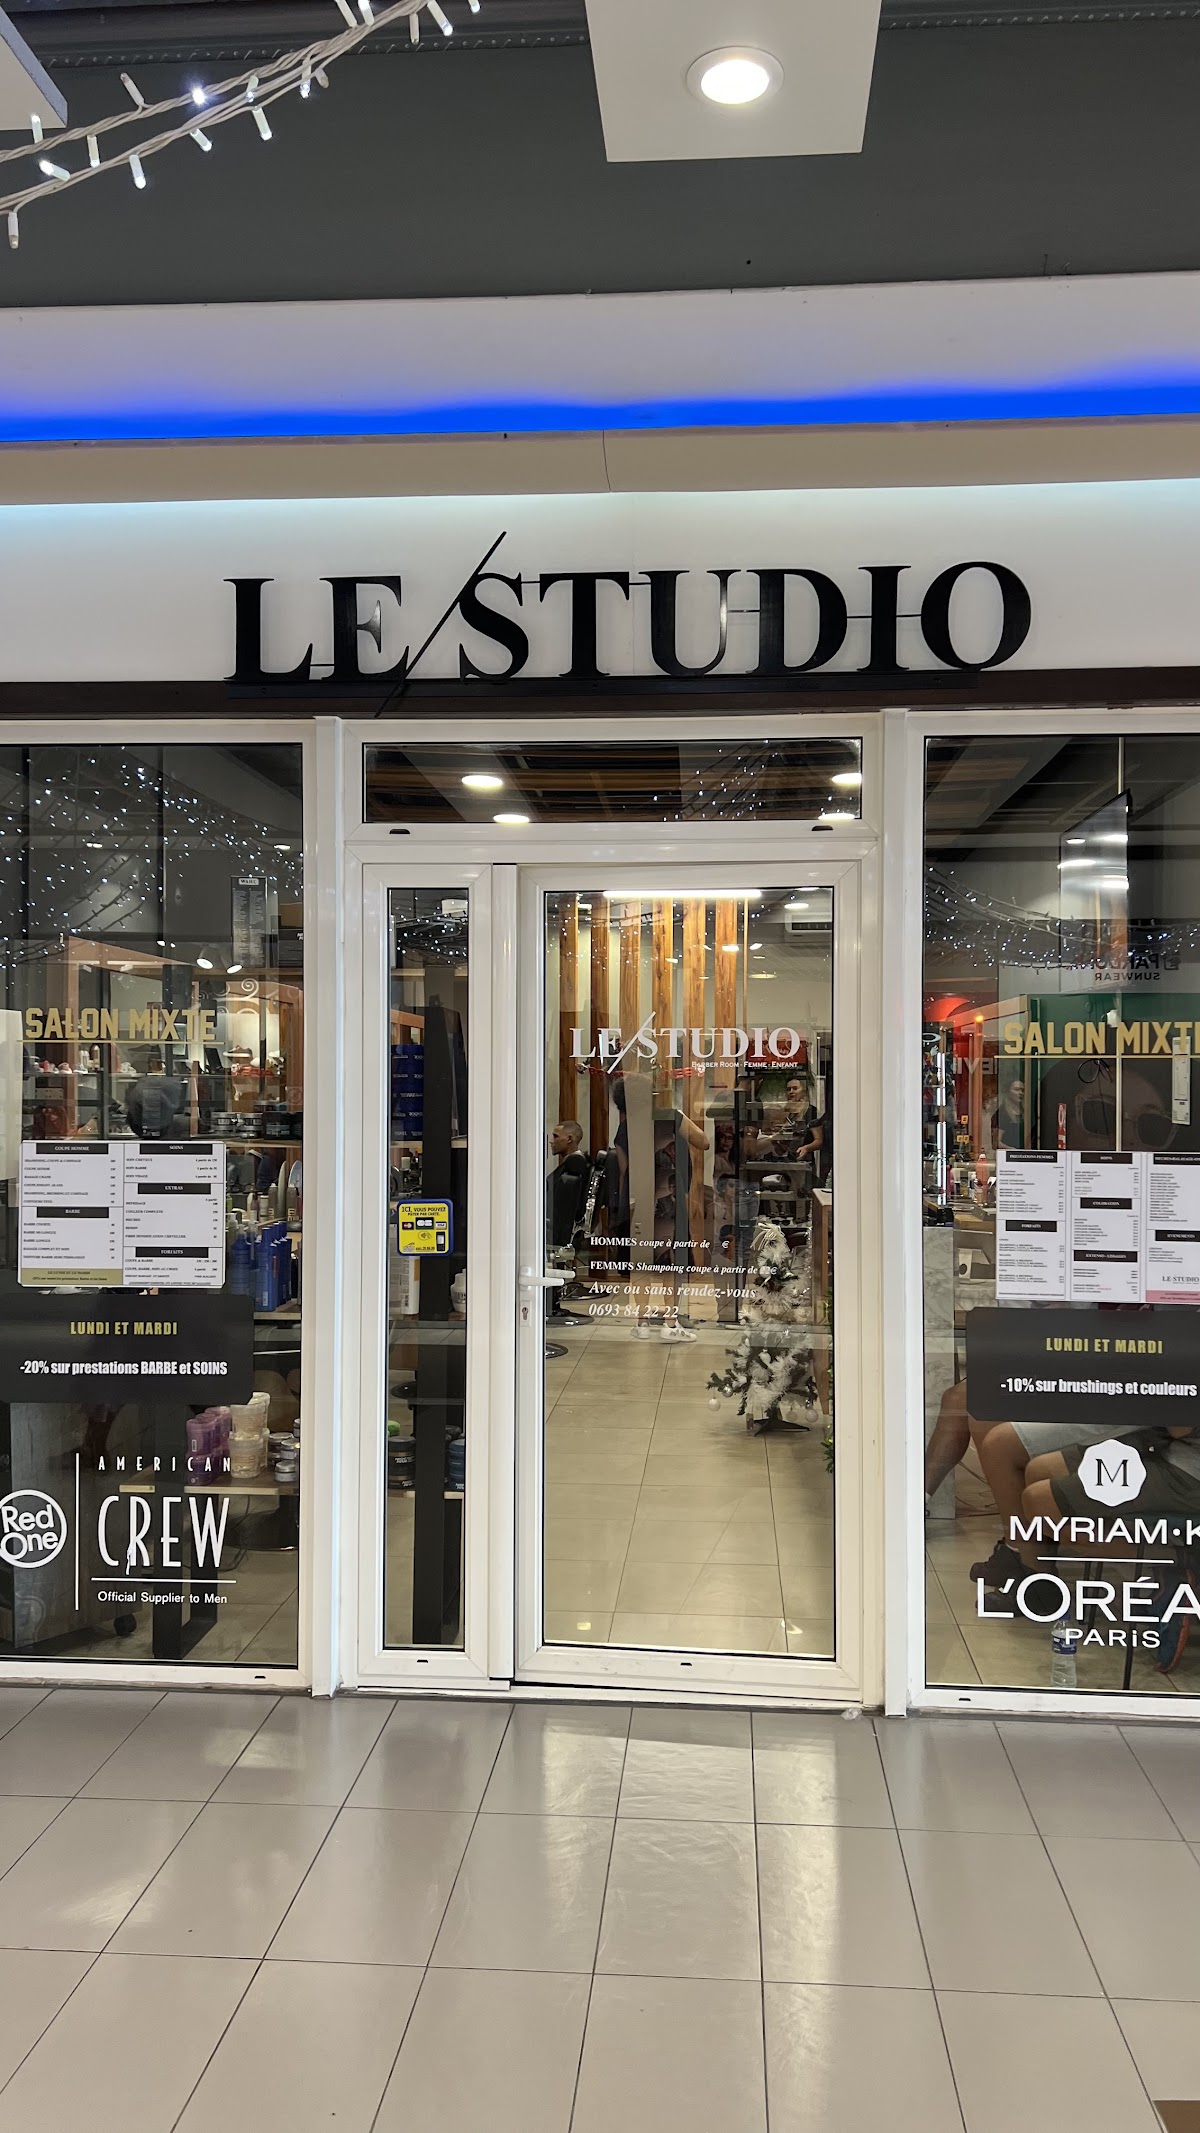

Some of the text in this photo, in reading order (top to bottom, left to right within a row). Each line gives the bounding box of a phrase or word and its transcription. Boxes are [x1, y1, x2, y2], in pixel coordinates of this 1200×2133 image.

[26, 1008, 216, 1040] SALON MIXTE
[1004, 1022, 1106, 1054] SALON
[591, 1236, 637, 1246] HOMMES
[639, 1240, 664, 1248] coupe
[666, 1239, 671, 1247] à
[673, 1240, 698, 1249] partir
[700, 1239, 710, 1248] de
[636, 1262, 684, 1273] Shampoing
[686, 1265, 712, 1274] coupe
[714, 1265, 719, 1273] à
[721, 1266, 746, 1275] partir
[747, 1266, 758, 1274] de
[589, 1281, 757, 1298] Avec ou sans rendez-vous
[589, 1304, 679, 1318] 0693 84 22 22
[70, 1321, 178, 1336] LUNDI ET MARDI
[1046, 1337, 1163, 1354] LUNDI ET MARDI
[20, 1360, 227, 1376] -20% sur prestations BARBE et SOINS
[1001, 1378, 1197, 1397] -10% sur brushings et couleurs
[98, 1456, 232, 1472] AMERICAN
[1095, 1458, 1129, 1487] M
[2, 1504, 54, 1533] Red
[98, 1496, 230, 1568] CREW
[0, 1532, 59, 1560] One
[98, 1590, 227, 1605] Official Supplier to Men
